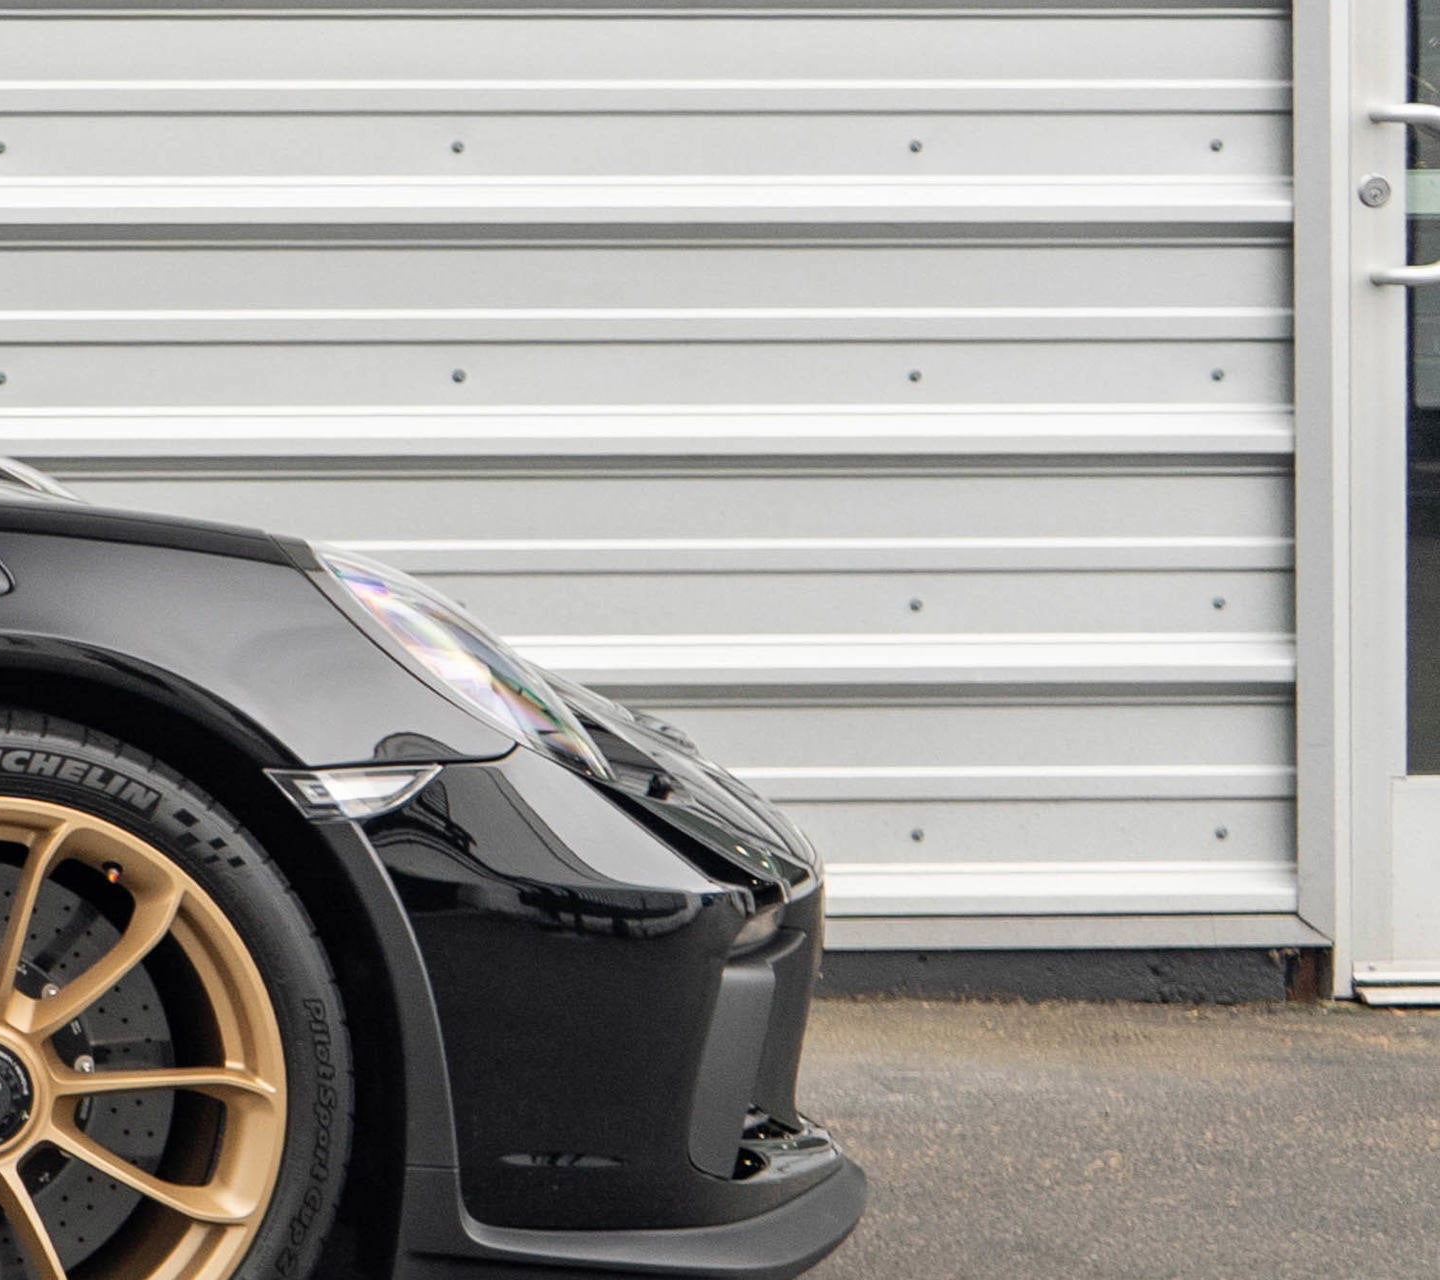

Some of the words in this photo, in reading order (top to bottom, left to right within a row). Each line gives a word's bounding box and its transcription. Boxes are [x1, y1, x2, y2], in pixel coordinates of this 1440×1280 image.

[304, 998, 335, 1080] Pilot
[309, 1085, 336, 1187] Sport
[289, 1188, 323, 1247] Cup
[274, 1247, 300, 1276] 2
